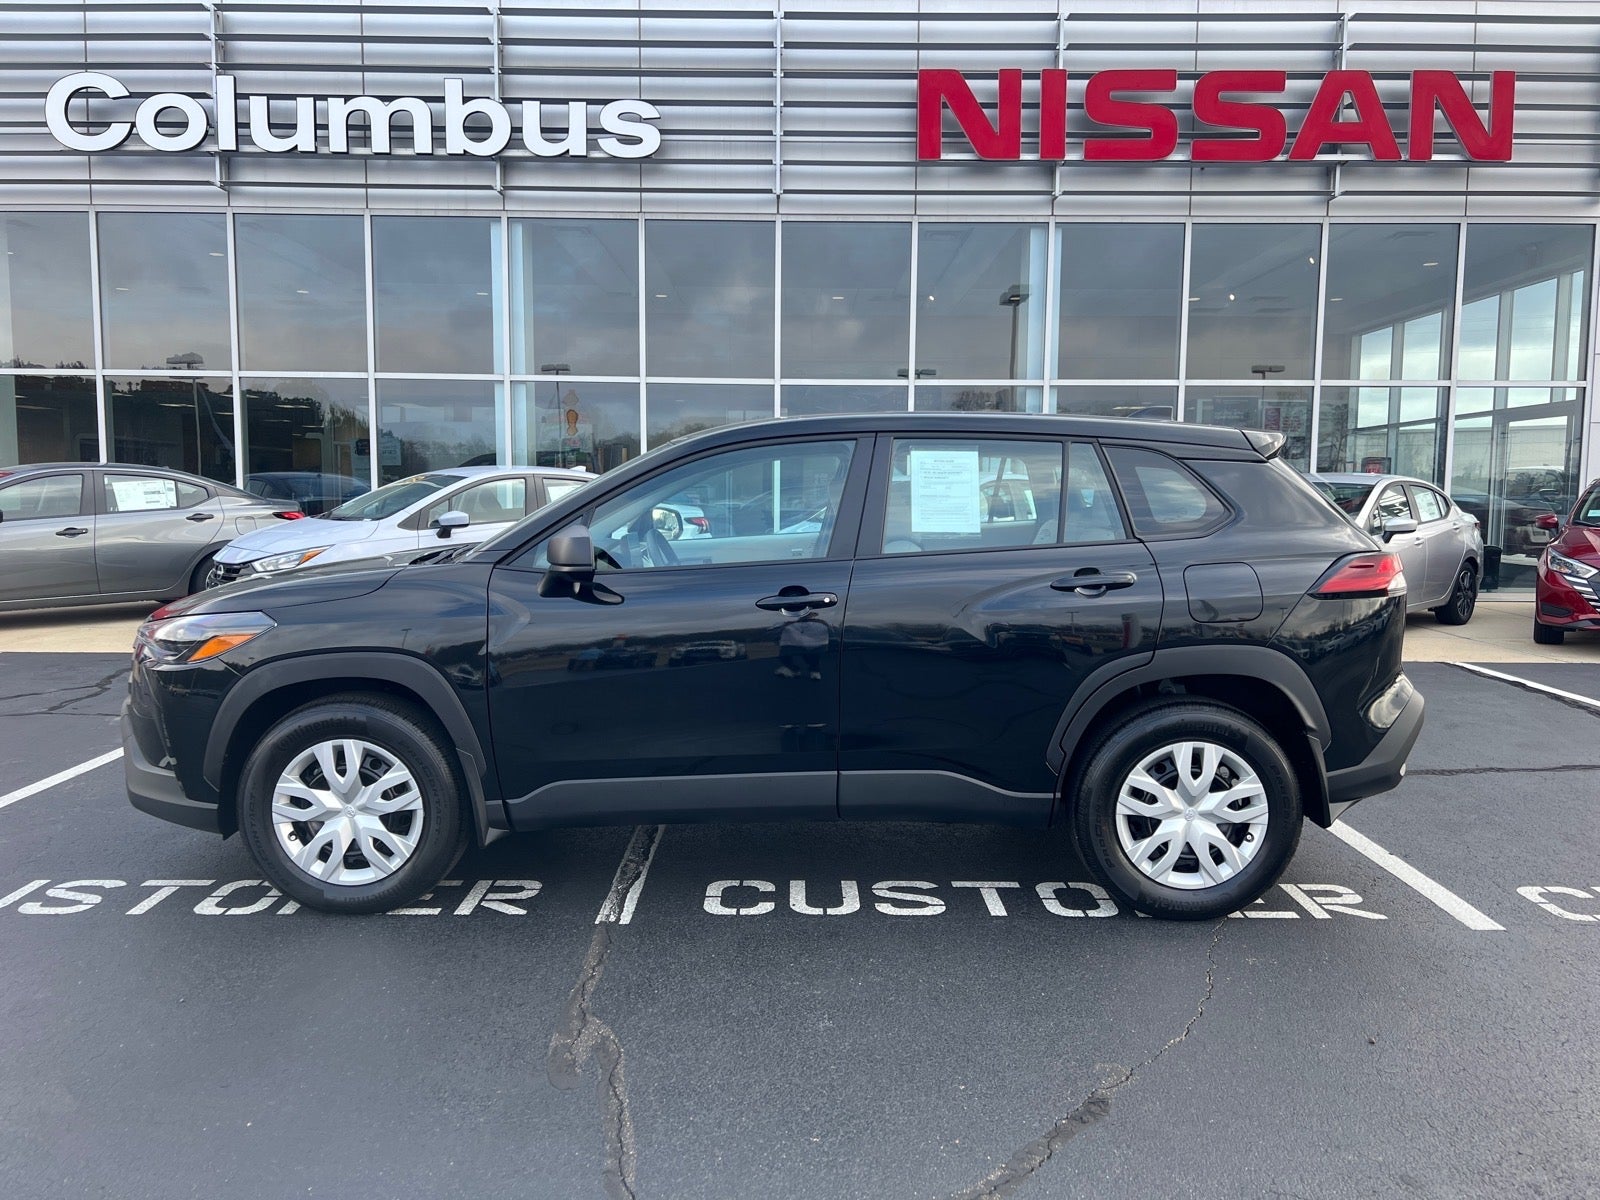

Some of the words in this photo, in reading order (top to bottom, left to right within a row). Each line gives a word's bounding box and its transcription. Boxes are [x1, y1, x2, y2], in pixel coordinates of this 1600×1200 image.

[44, 71, 662, 158] Columbus
[917, 68, 1516, 163] NISSAN
[0, 879, 542, 915] STOER
[703, 880, 1388, 919] CUSTOR
[1516, 886, 1600, 921] C
